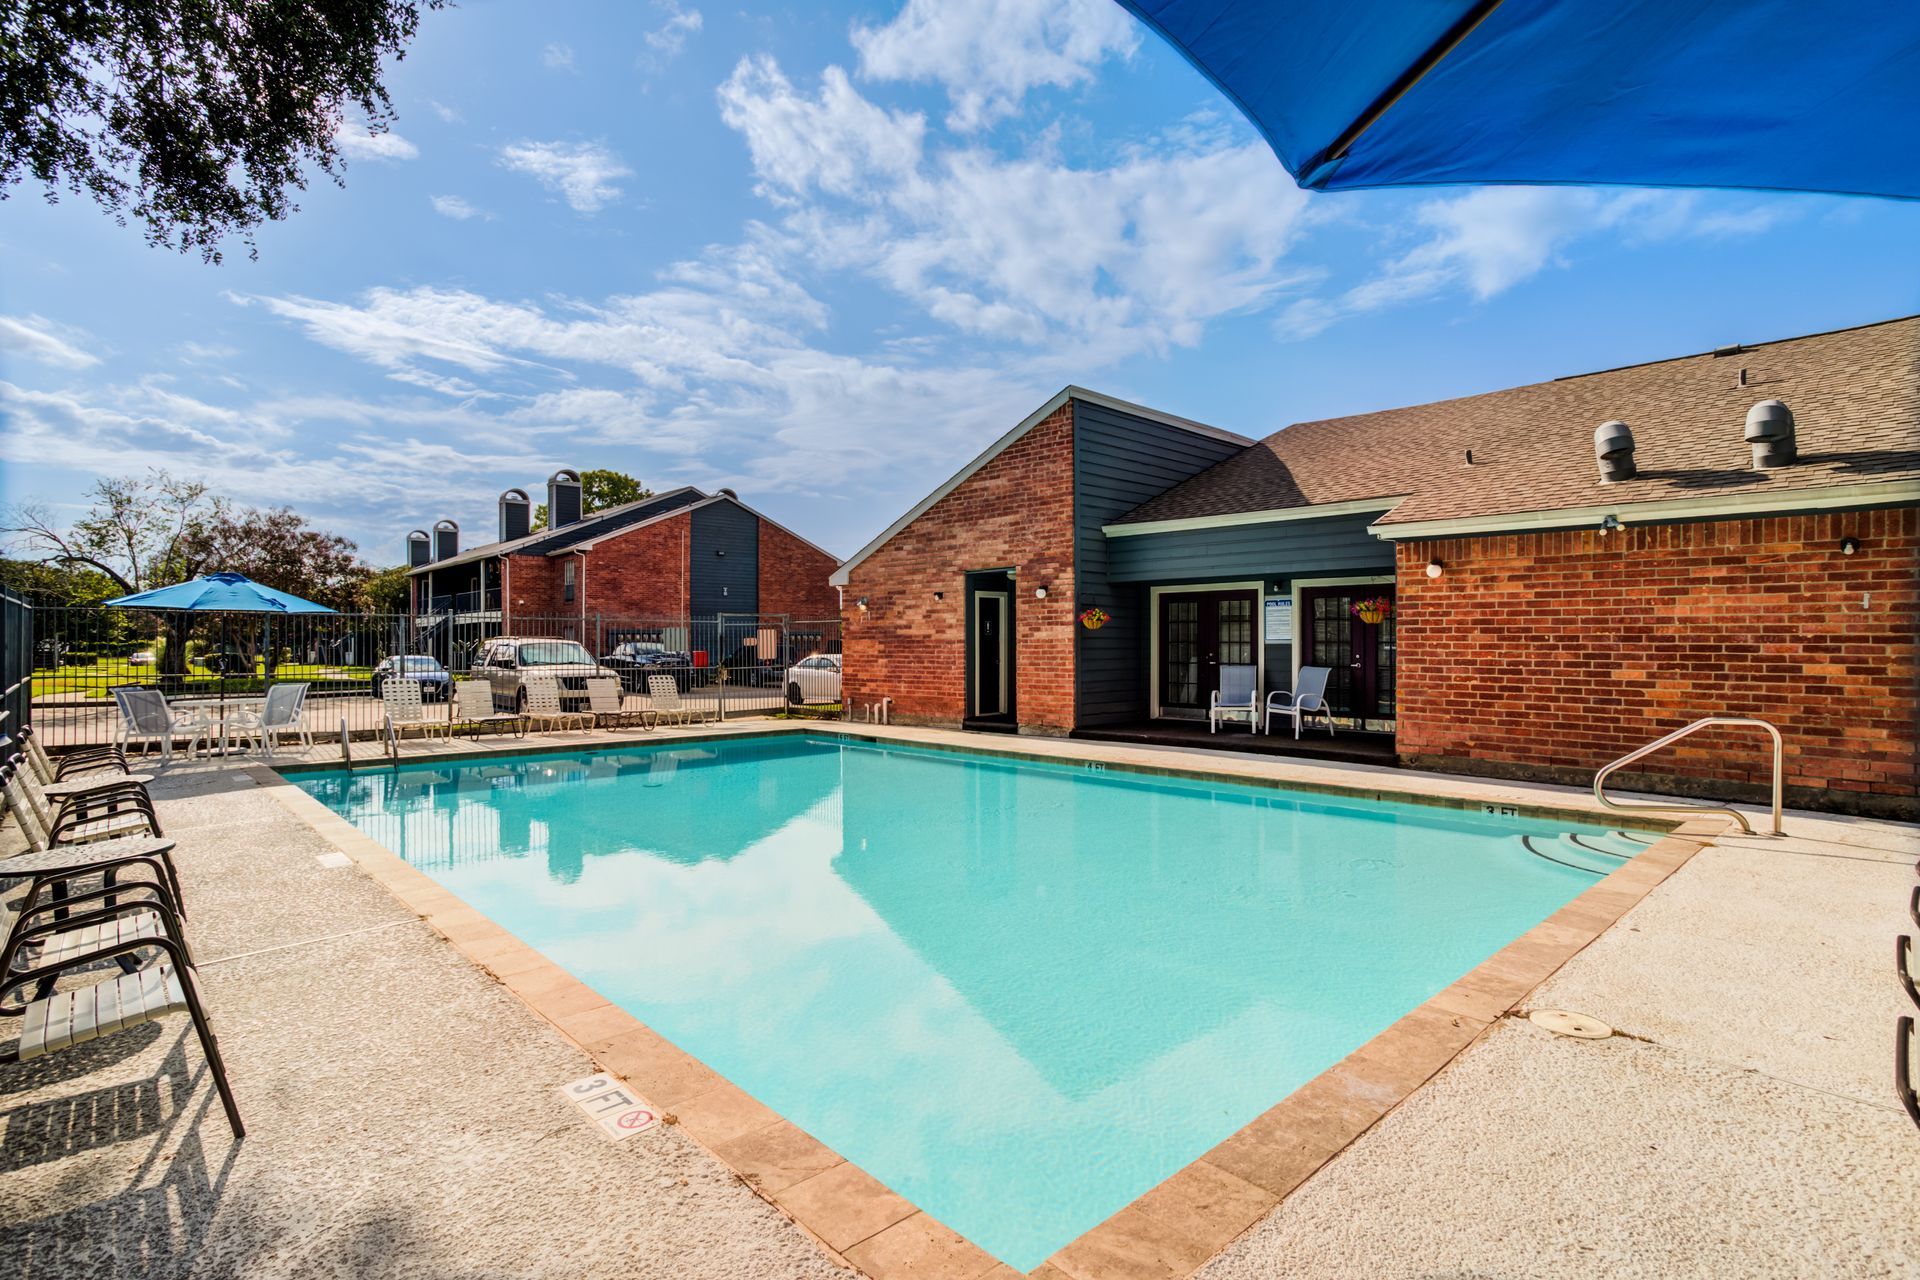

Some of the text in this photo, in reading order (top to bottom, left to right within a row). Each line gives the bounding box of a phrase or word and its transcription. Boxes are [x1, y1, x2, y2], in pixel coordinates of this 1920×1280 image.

[1486, 806, 1517, 816] 3 FT
[572, 1079, 634, 1113] 3 FT
